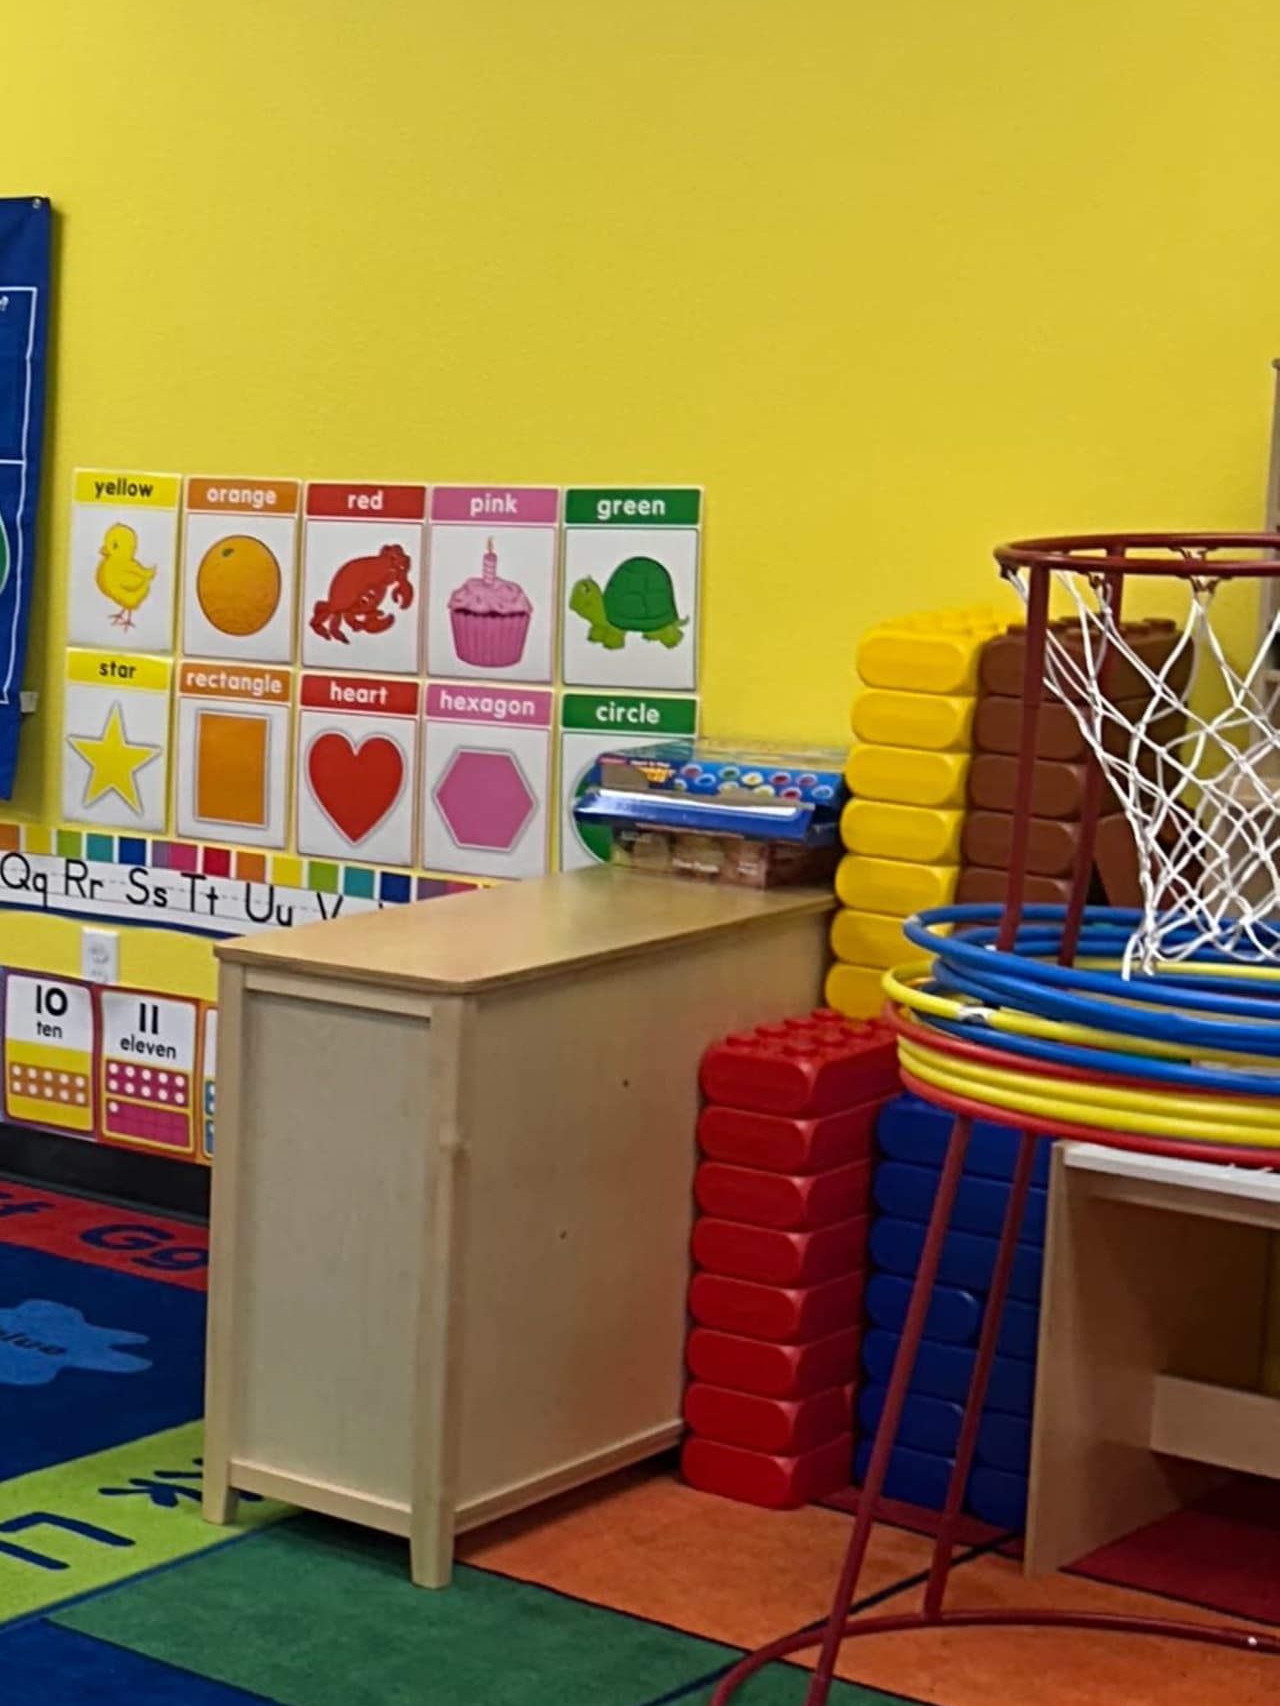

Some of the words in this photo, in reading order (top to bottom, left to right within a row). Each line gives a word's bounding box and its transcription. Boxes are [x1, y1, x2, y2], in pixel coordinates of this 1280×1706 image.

[94, 478, 154, 500] yellow
[206, 487, 277, 508] orange
[347, 491, 384, 510] red
[470, 493, 518, 515] pink
[596, 496, 666, 519] green
[98, 661, 136, 680] star
[186, 671, 283, 696] rectangle
[329, 685, 388, 706] heart
[439, 692, 535, 718] hexagon
[595, 703, 661, 725] circle
[0, 851, 49, 910] Qq
[64, 859, 103, 901] Rr
[126, 868, 167, 909] Ss
[180, 872, 219, 915] Tt
[245, 883, 293, 926] Uu
[35, 984, 69, 1017] 10
[138, 1002, 160, 1034] 11
[37, 1020, 63, 1039] ten
[120, 1035, 178, 1061] eleven
[79, 1223, 209, 1271] Gg
